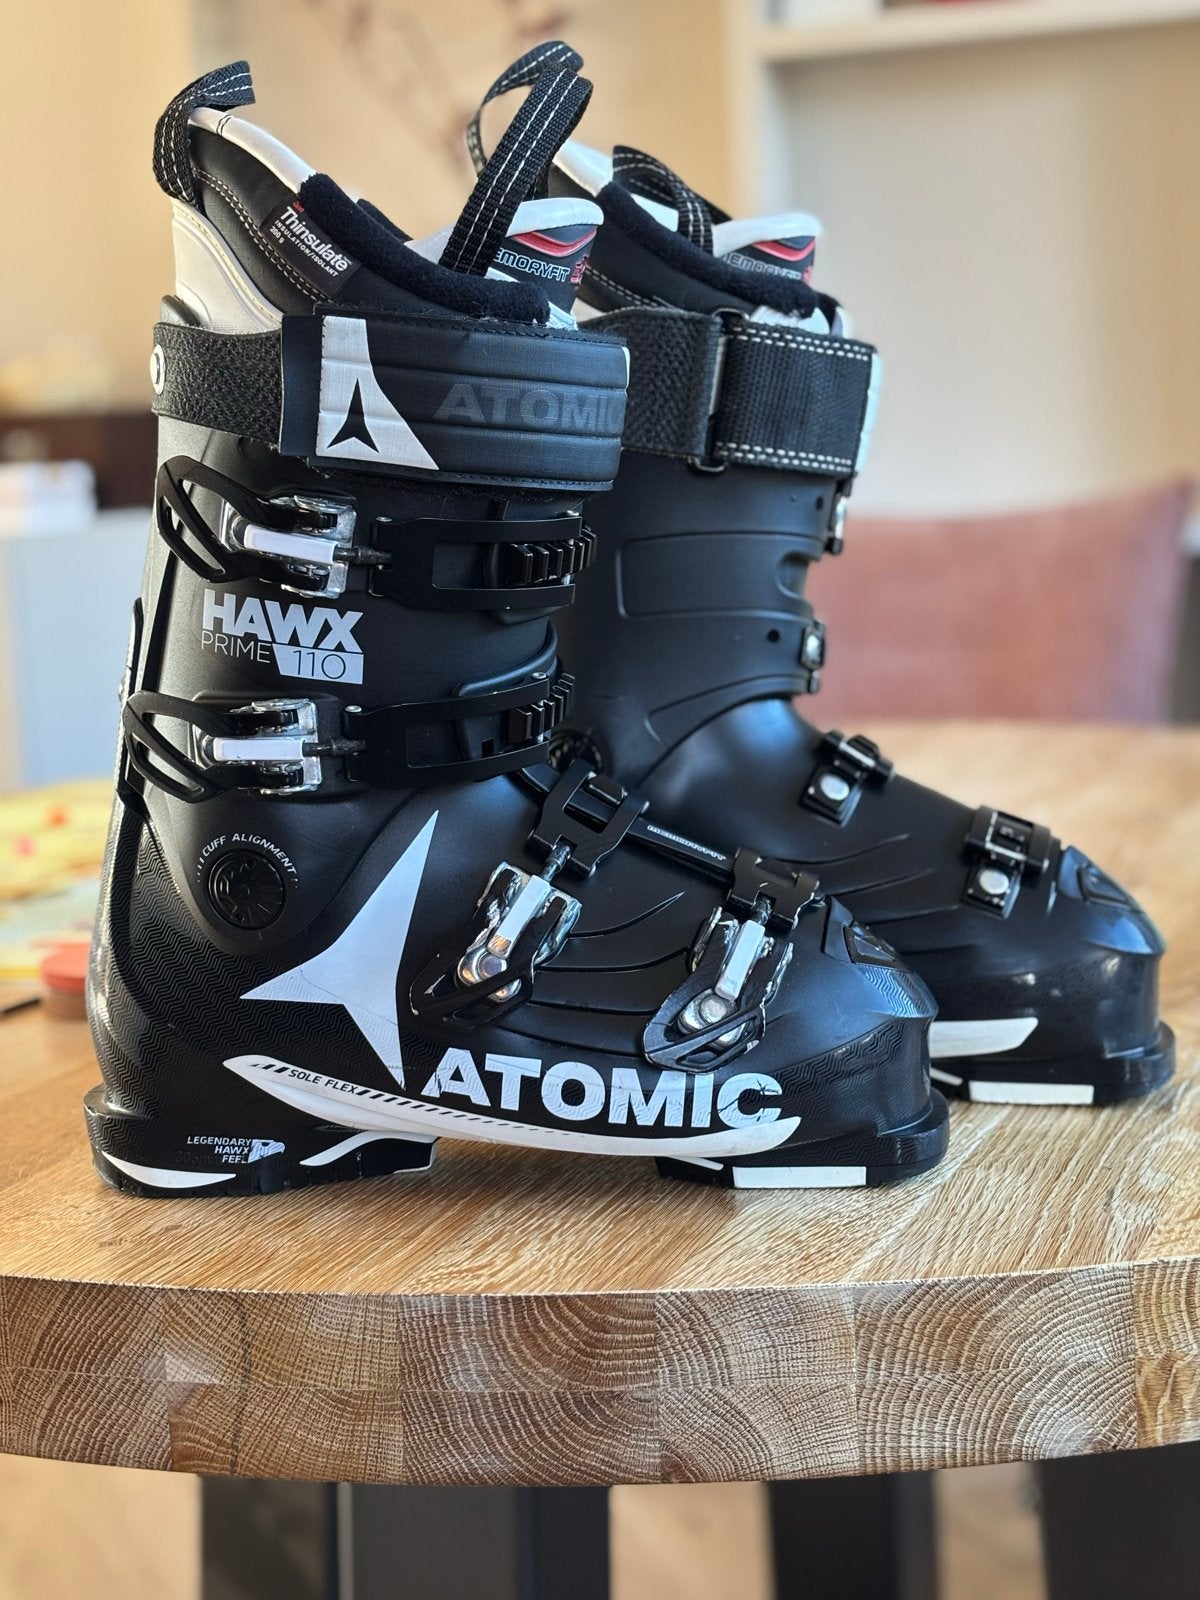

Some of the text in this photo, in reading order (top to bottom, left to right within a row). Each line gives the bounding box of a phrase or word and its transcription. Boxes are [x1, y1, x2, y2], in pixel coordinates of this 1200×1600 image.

[269, 226, 282, 239] 200
[274, 220, 339, 277] INSULATION/ISOLANT
[281, 206, 348, 271] Thinsulate
[433, 383, 626, 437] ATOMIC
[202, 588, 364, 653] HAWX
[201, 630, 346, 680] PRIME 110
[202, 833, 298, 875] CUFF ALIGNMENT
[288, 1069, 359, 1095] SOLE FLEX
[420, 1047, 784, 1129] ATOMIC
[187, 1136, 252, 1147] LEGENDARY
[214, 1145, 251, 1155] HAWX
[222, 1154, 249, 1164] FEEL
